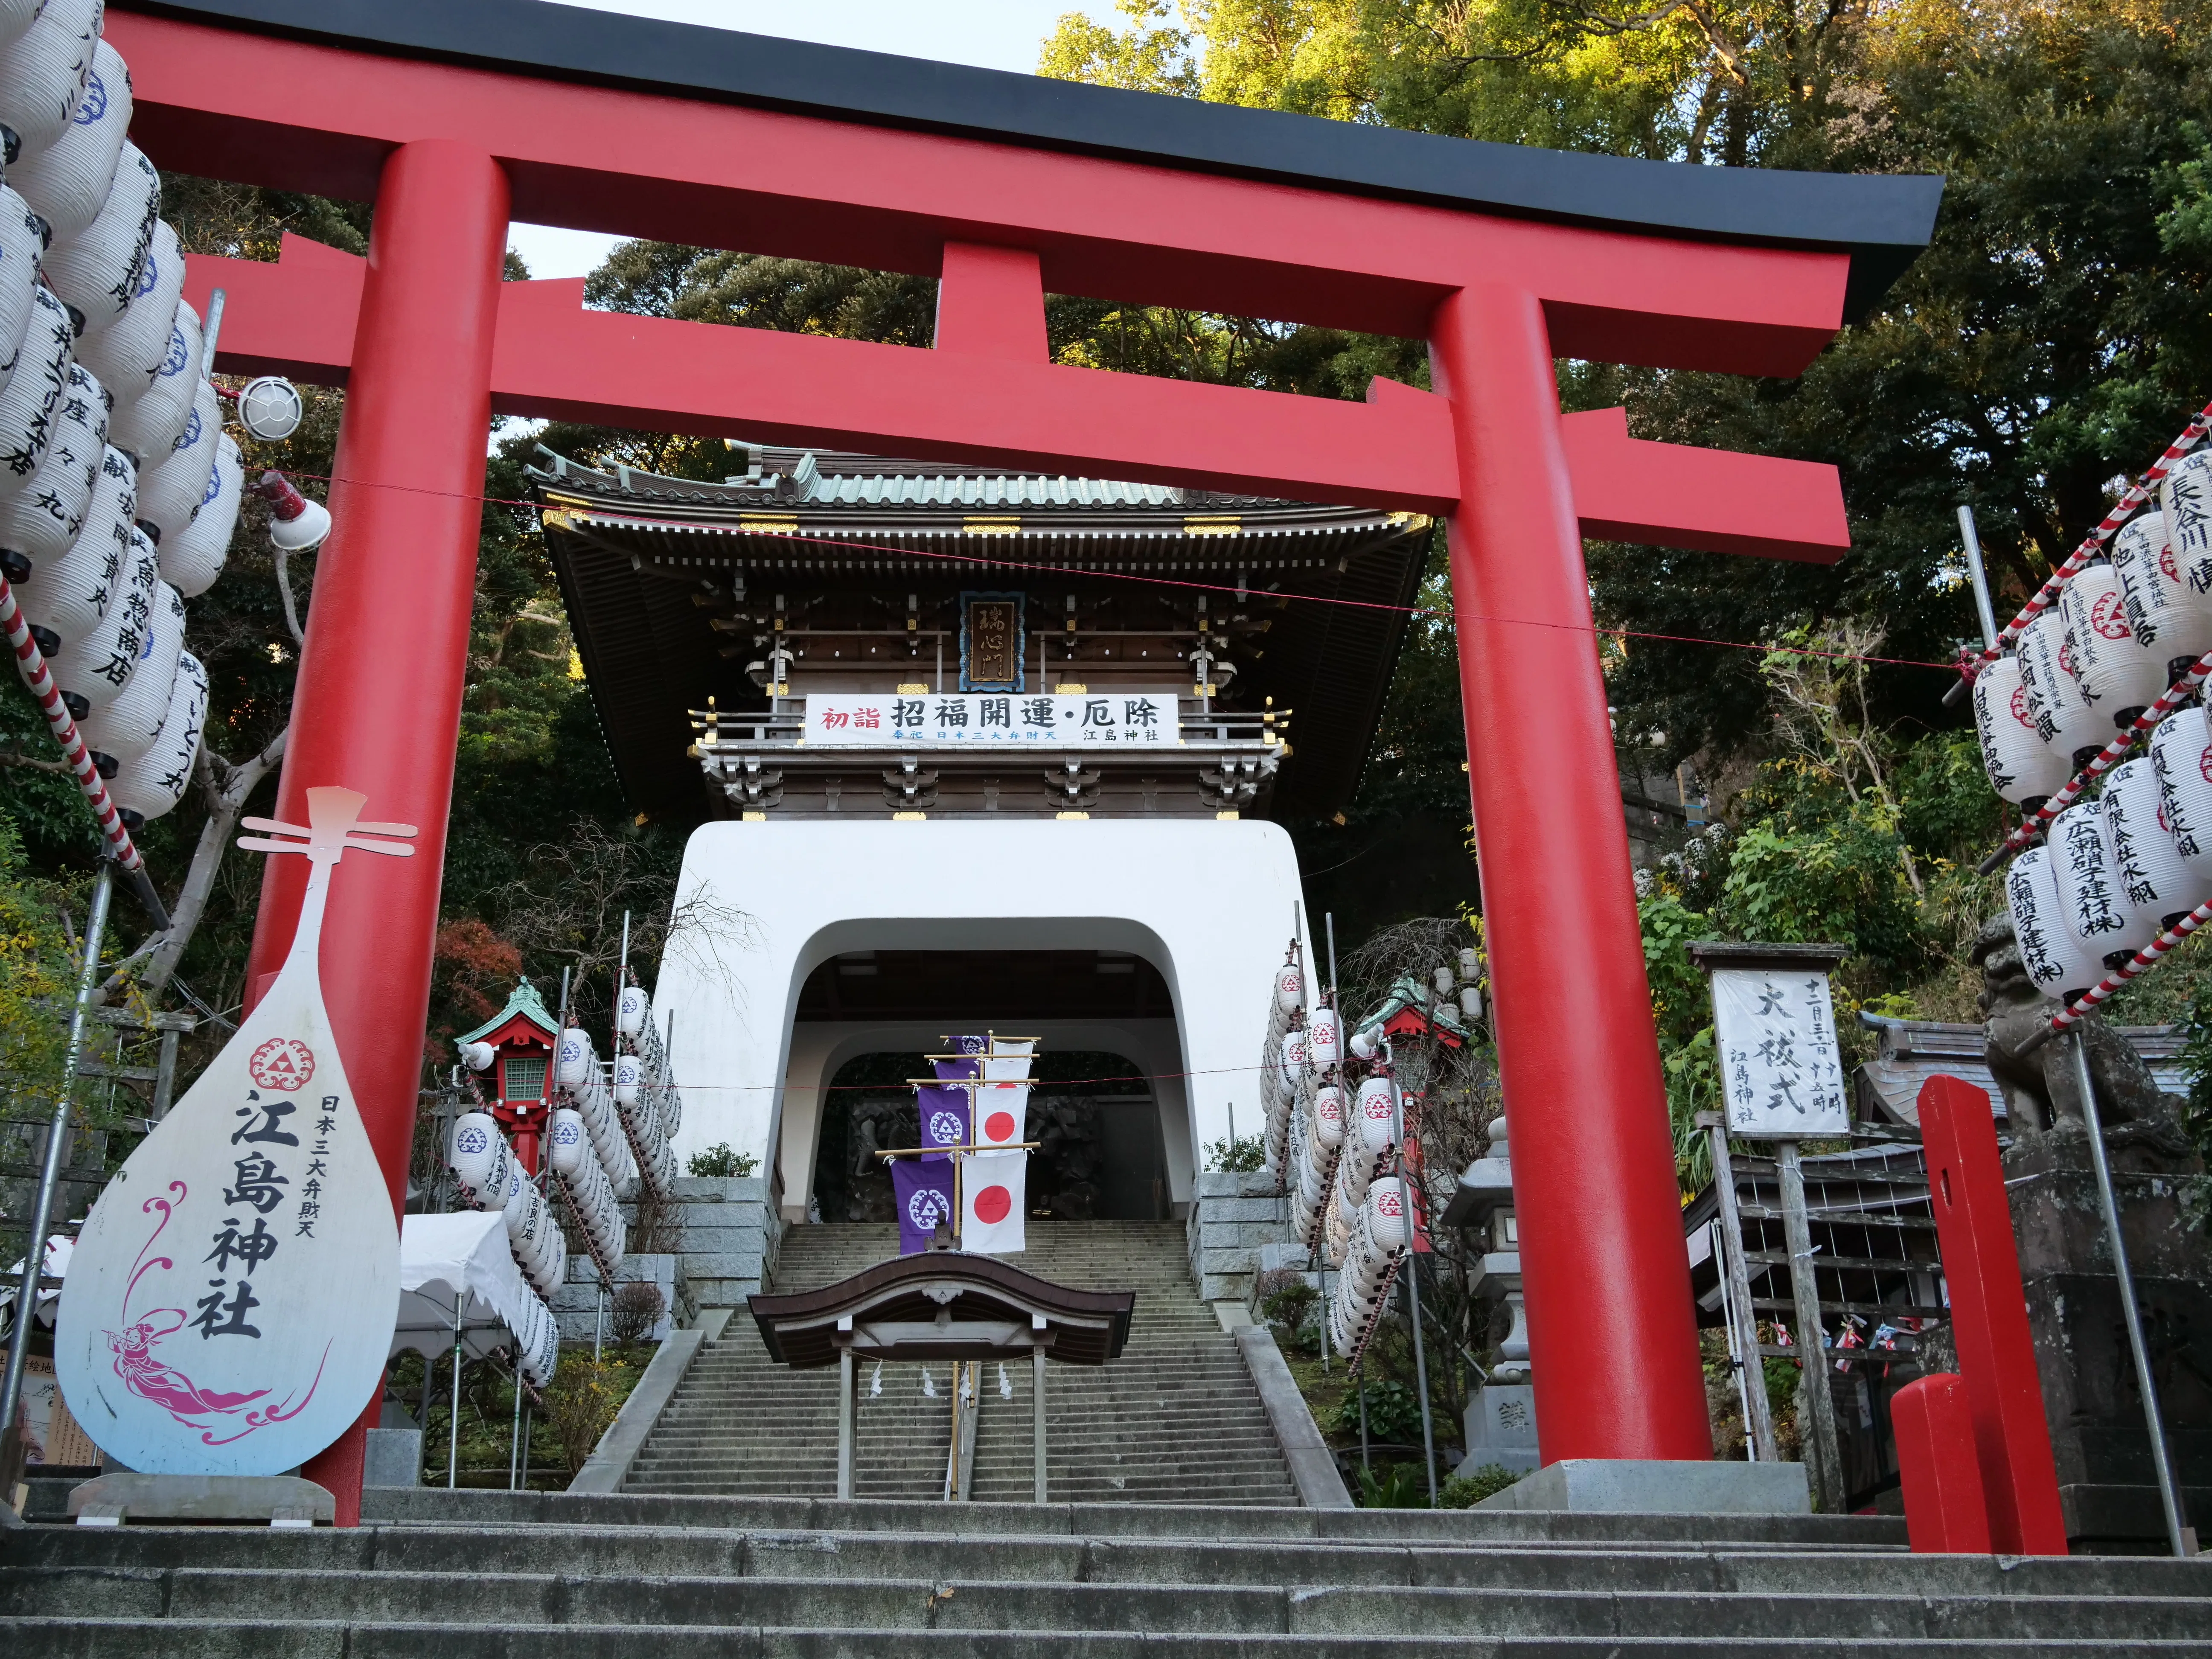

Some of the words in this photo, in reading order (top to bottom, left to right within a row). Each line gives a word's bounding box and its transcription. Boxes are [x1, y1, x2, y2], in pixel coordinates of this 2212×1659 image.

[103, 453, 130, 486] 献
[979, 605, 1006, 678] 瑞心門
[820, 707, 881, 731] 初詣
[890, 697, 1161, 729] 招福開運・厄除
[937, 731, 1058, 740] 日本三大弁財天
[1083, 729, 1159, 742] 江島神社
[1805, 978, 1831, 1056] 十二月三十一日
[1751, 983, 1806, 1115] 大祓式
[1729, 1048, 1758, 1125] 江島神社
[1809, 1062, 1826, 1113] 十五時
[1825, 1062, 1841, 1115] 十一時
[294, 1095, 341, 1239] 日本三大弁財天
[188, 1090, 300, 1341] 江島神社
[521, 1196, 541, 1241] 吉良の店
